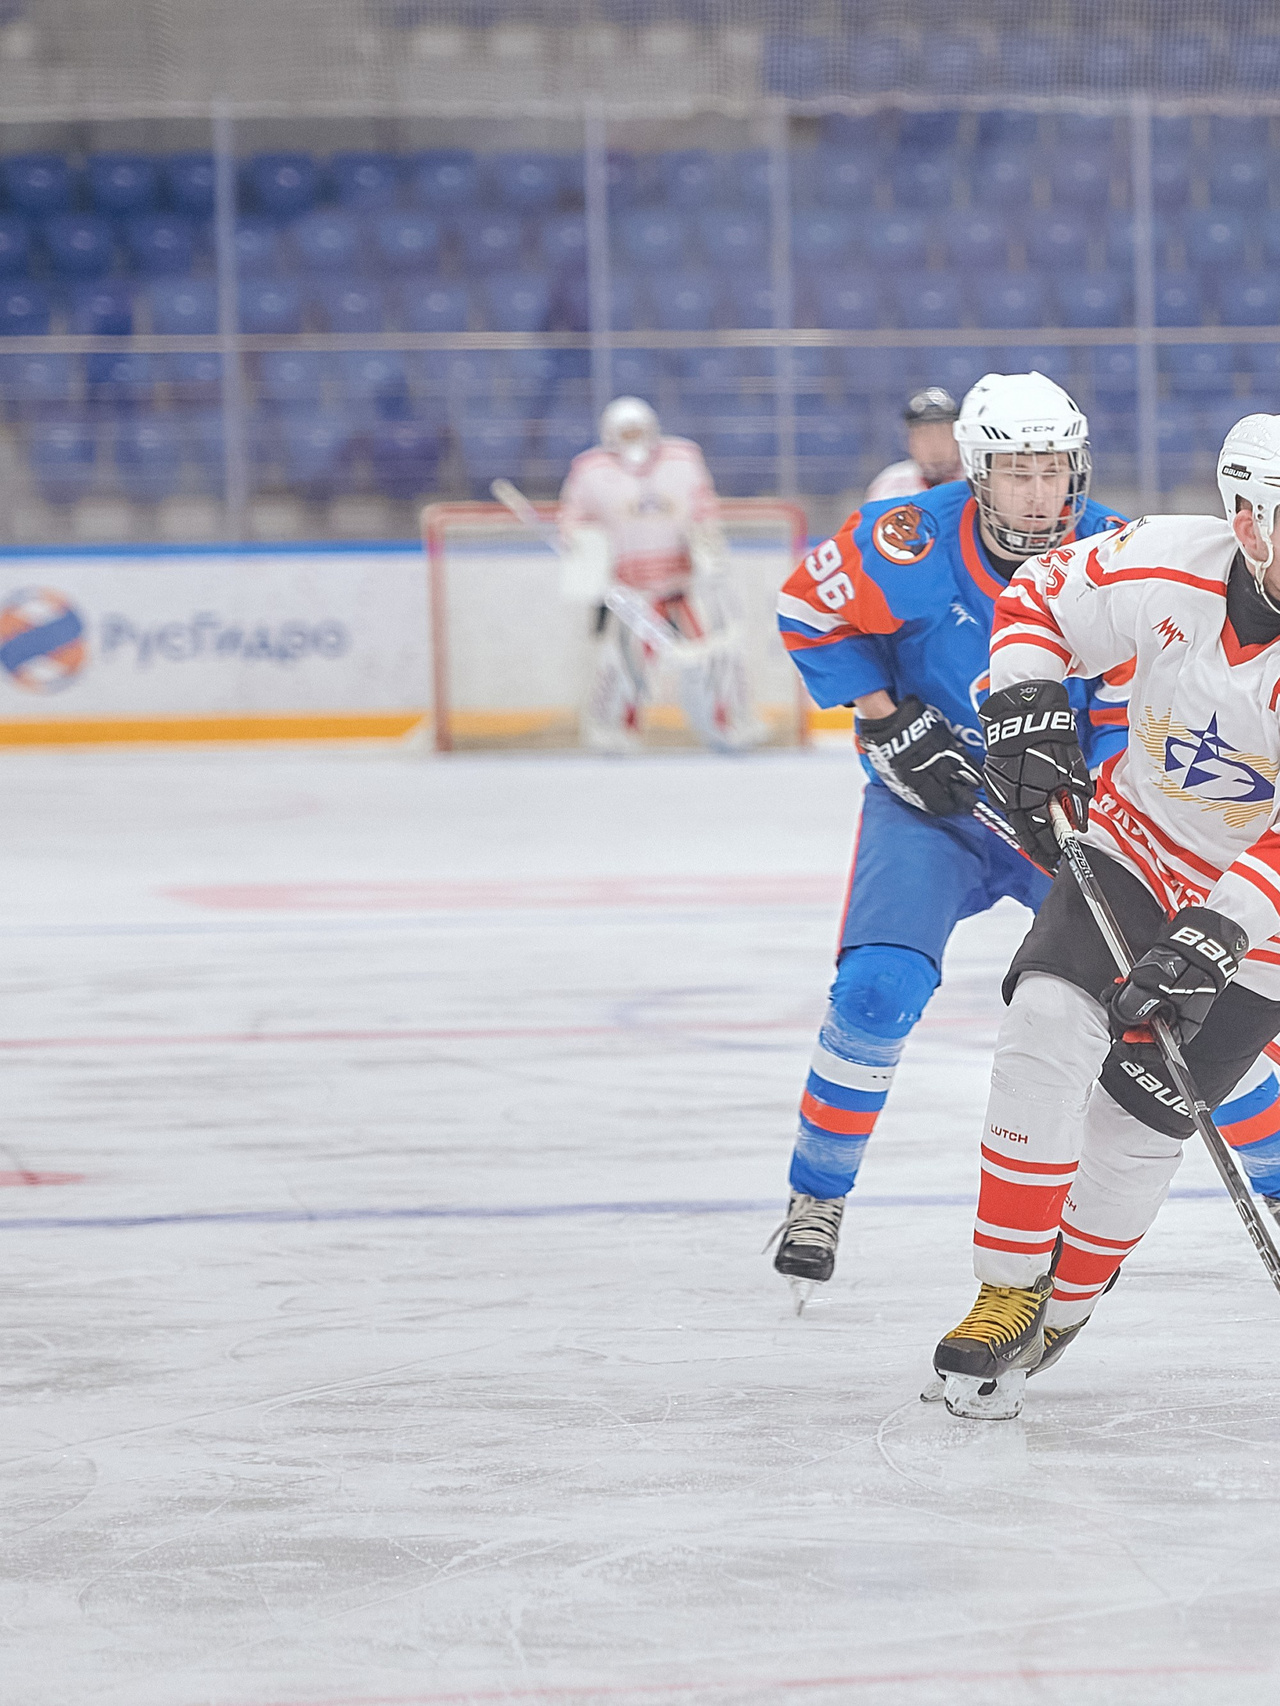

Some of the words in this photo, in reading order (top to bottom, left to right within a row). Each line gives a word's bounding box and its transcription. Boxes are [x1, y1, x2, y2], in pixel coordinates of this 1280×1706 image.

[805, 539, 855, 611] 96
[1170, 926, 1238, 982] BAU
[1120, 1060, 1193, 1118] BAUE
[990, 1123, 1028, 1145] LUTCH
